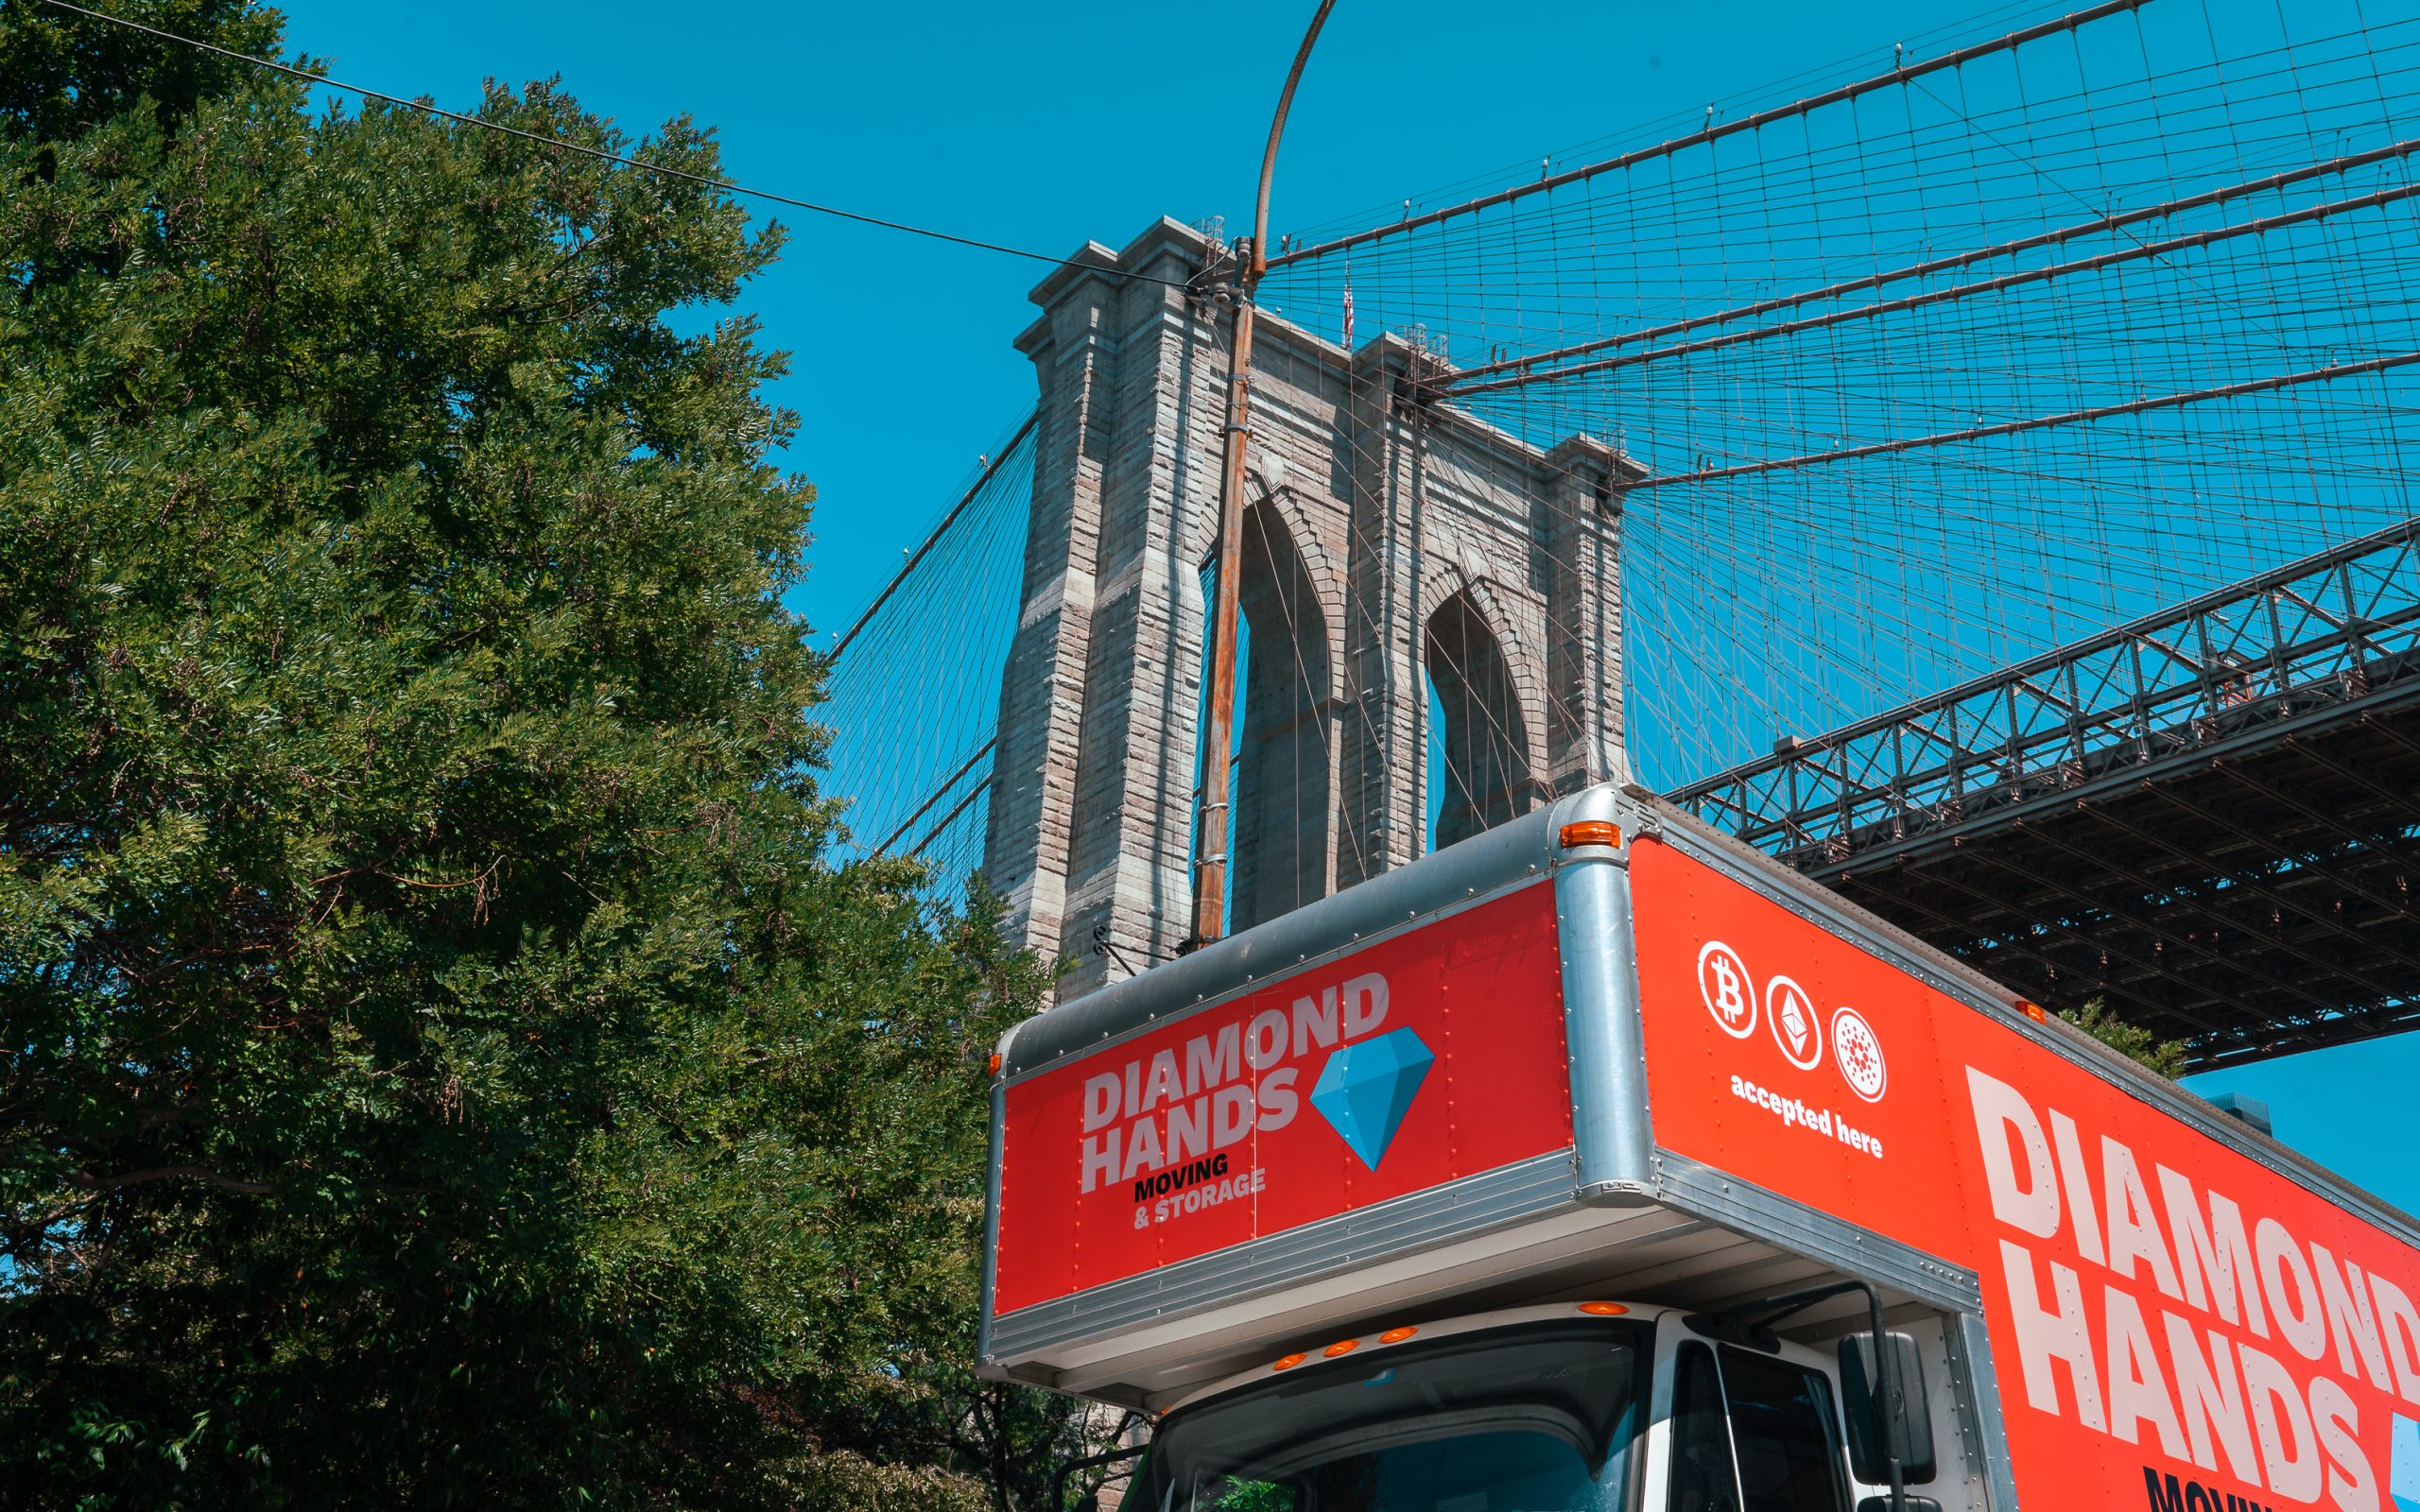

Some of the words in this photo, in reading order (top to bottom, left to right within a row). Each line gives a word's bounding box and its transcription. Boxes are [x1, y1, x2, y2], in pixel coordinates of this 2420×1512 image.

[1084, 972, 1390, 1133] DIAMOND
[1081, 1067, 1299, 1194] HANDS
[1134, 1153, 1228, 1203] MOVING
[1731, 1075, 1833, 1137] accepted
[1835, 1114, 1883, 1159] here
[1134, 1206, 1150, 1229] &
[1154, 1167, 1266, 1223] STORAGE
[1965, 1065, 2420, 1406] DIAMOND
[1999, 1239, 2380, 1512] HANDS
